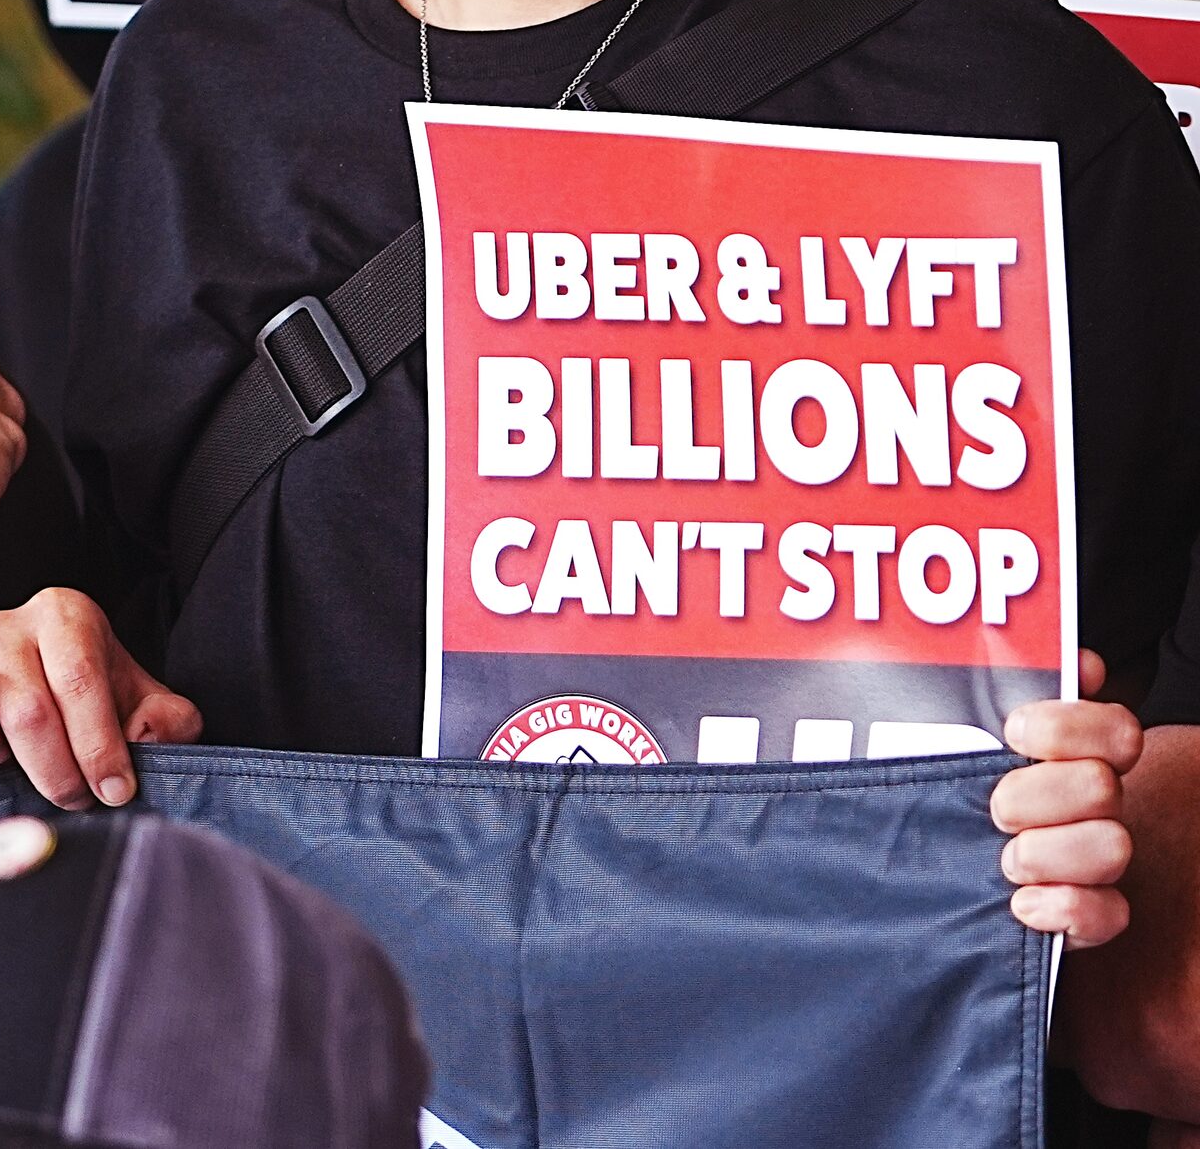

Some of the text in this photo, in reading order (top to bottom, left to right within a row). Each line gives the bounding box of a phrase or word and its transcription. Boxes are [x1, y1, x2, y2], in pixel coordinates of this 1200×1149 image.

[471, 230, 1019, 330] UBER & LYFT
[476, 355, 1029, 491] BILLIONS
[469, 516, 1040, 626] CAN'T STOP
[527, 703, 574, 734] GIG
